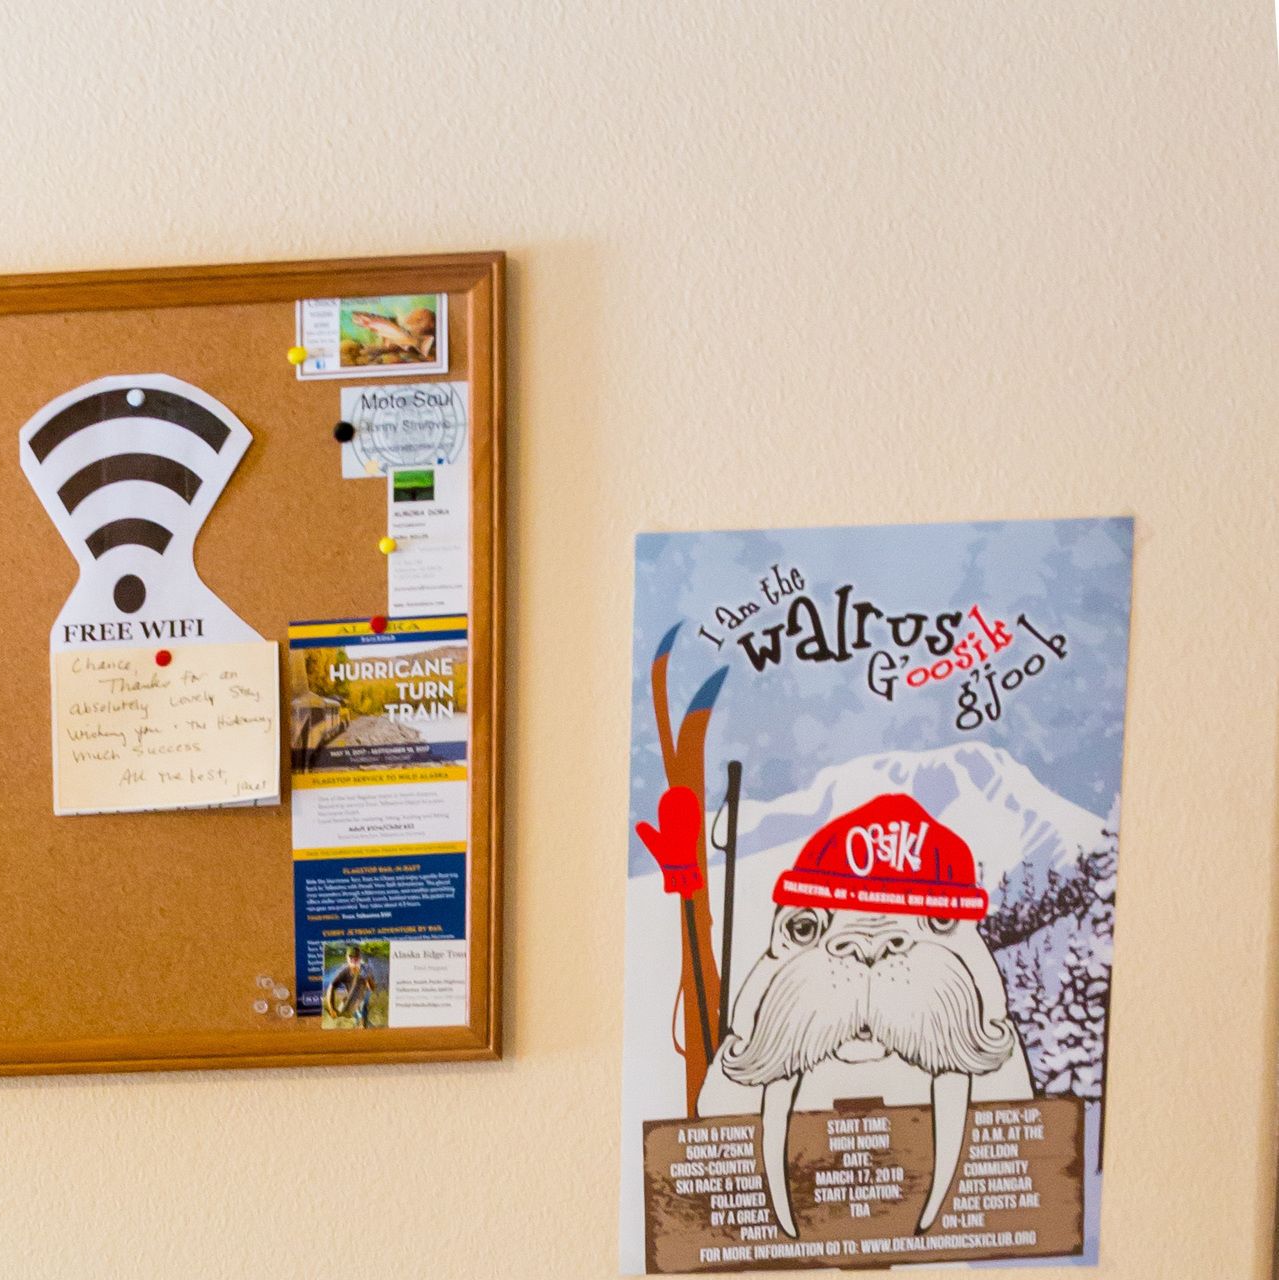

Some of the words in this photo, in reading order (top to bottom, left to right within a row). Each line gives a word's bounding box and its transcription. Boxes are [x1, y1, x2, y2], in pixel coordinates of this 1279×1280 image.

[361, 393, 407, 410] Moto
[698, 624, 725, 650] I
[759, 564, 807, 606] the
[63, 622, 133, 644] FREE
[139, 619, 205, 640] WIFI
[737, 584, 963, 673] walrus
[329, 658, 454, 682] HURRICANE
[396, 680, 455, 700] TURN
[384, 701, 455, 723] TRAIN
[845, 820, 930, 877] Oosik!
[392, 950, 420, 960] Alaska
[423, 949, 444, 961] Edge
[678, 1128, 686, 1144] A
[687, 1128, 709, 1143] FUN
[720, 1125, 756, 1141] FUNKY
[827, 1118, 860, 1135] START
[1007, 1126, 1022, 1141] AT
[1023, 1124, 1045, 1141] THE
[829, 1136, 855, 1152] HIGH
[969, 1143, 1019, 1160] SHELDON
[669, 1159, 757, 1178] CROSS-COUNTRY
[815, 1169, 854, 1186] MARCH
[963, 1160, 1029, 1177] COMMUNITY
[675, 1179, 694, 1194] SKI
[695, 1178, 723, 1193] RACE
[735, 1175, 763, 1191] TOUR
[958, 1179, 987, 1194] ARTS
[988, 1176, 1033, 1193] HANGAR
[710, 1192, 766, 1209] FOLLOWED
[814, 1186, 847, 1203] START
[953, 1196, 981, 1212] RACE
[983, 1194, 1018, 1210] COSTS
[1018, 1192, 1041, 1208] ARE
[710, 1210, 725, 1227] BY
[726, 1210, 736, 1225] A
[736, 1208, 771, 1225] GREAT
[740, 1224, 778, 1241] PARTY!
[700, 1248, 721, 1263] FOR
[721, 1246, 753, 1262] MORE
[754, 1243, 824, 1260] INFORMATION
[826, 1241, 841, 1256] GO
